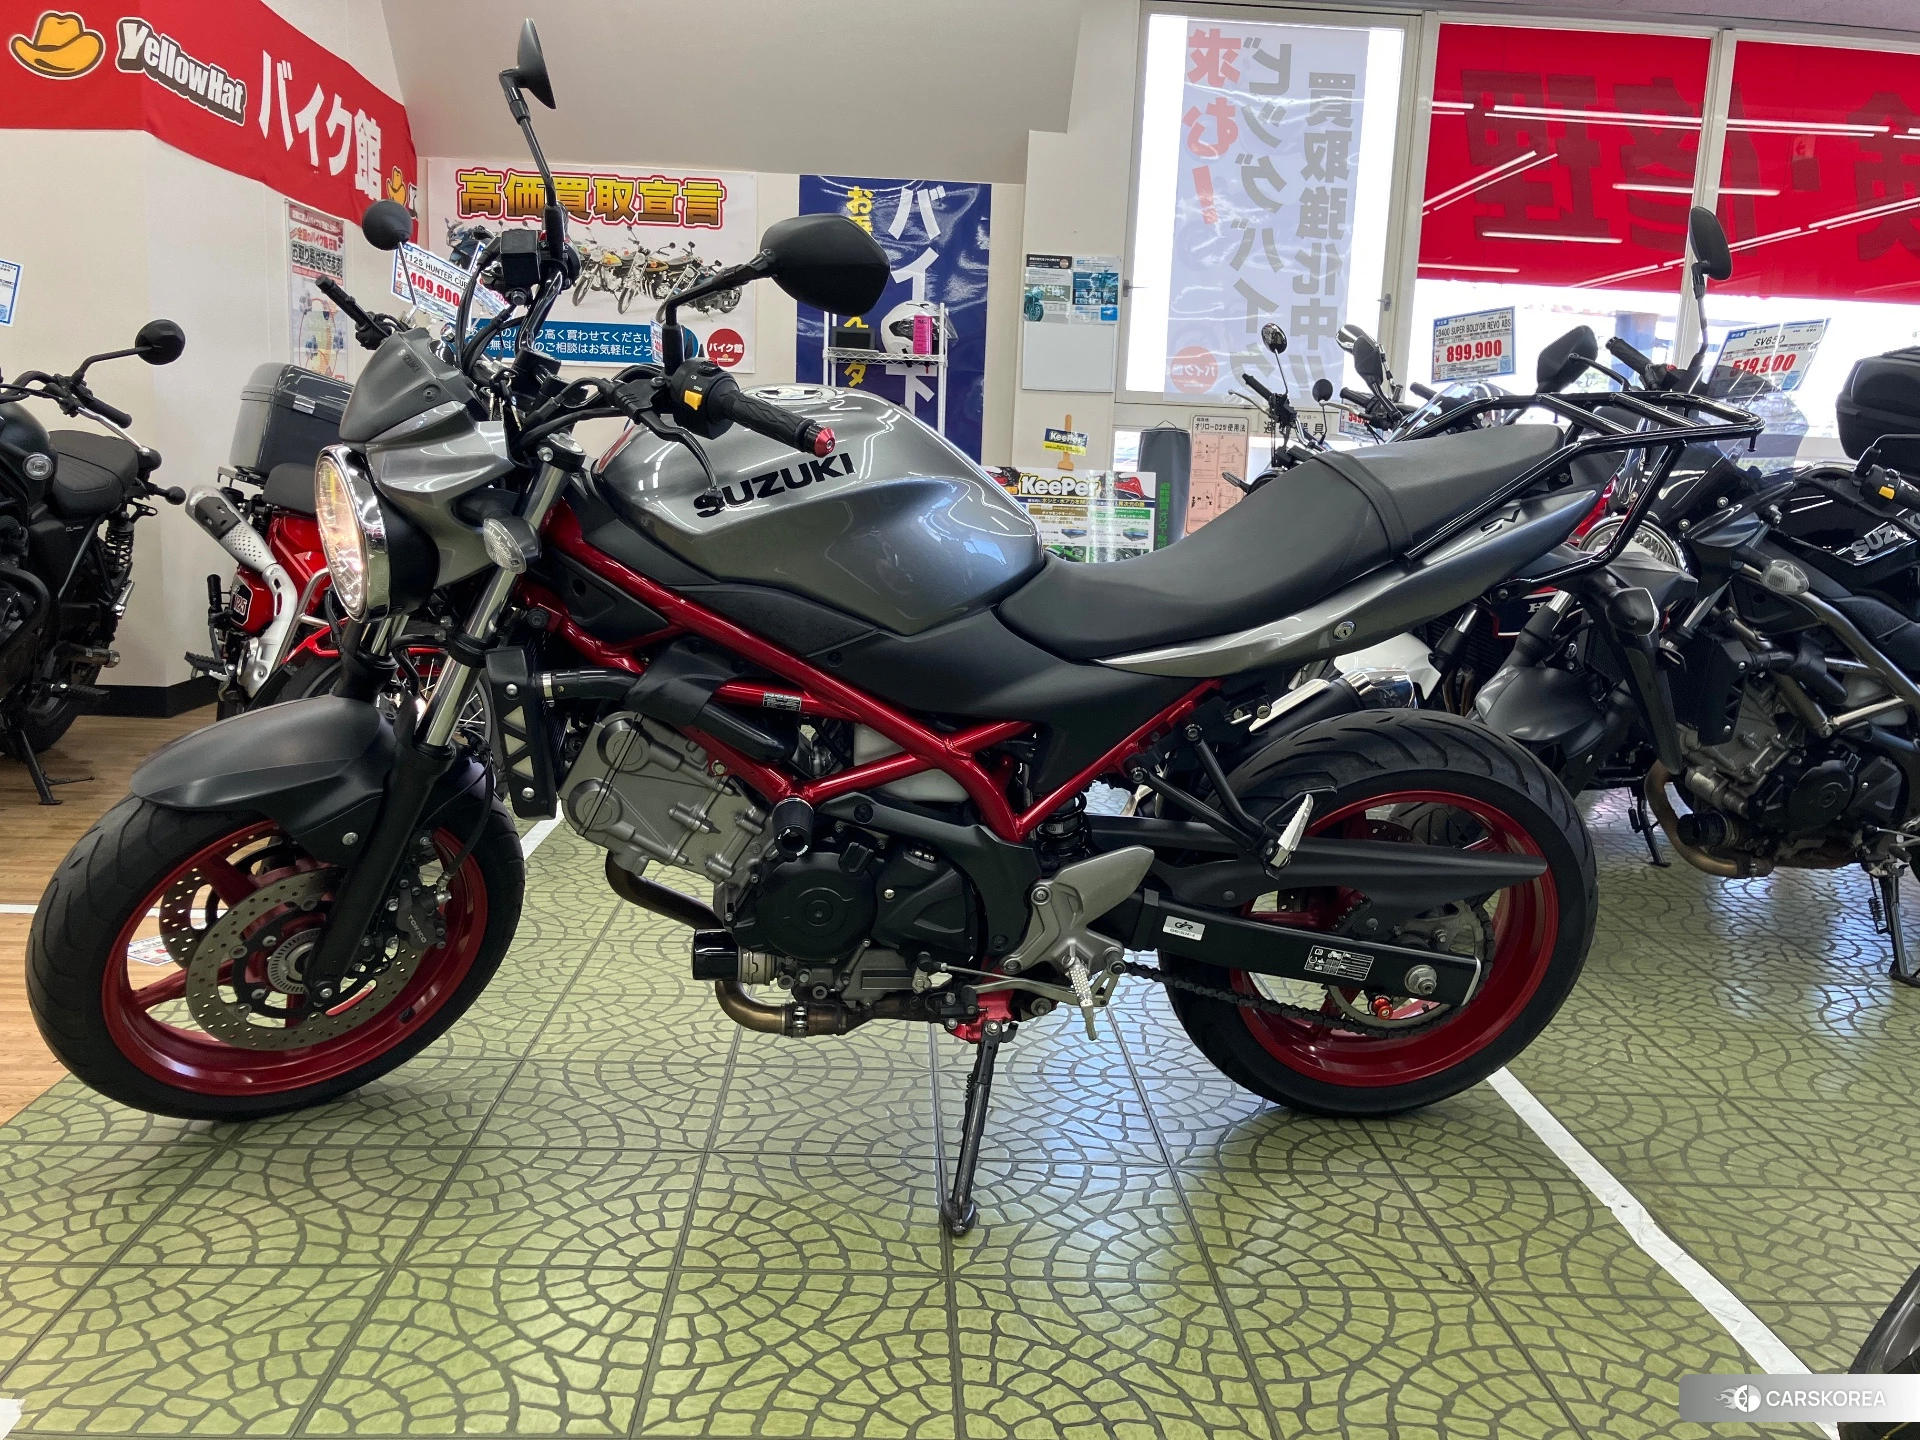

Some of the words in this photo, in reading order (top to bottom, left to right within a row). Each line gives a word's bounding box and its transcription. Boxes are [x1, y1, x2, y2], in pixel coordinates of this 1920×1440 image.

[118, 18, 246, 124] YellowHat
[258, 50, 382, 201] バイク館
[458, 168, 725, 228] 高価買取宣言
[425, 262, 453, 280] HUNTER
[1451, 325, 1465, 336] SUPER
[1754, 335, 1786, 347] SV650
[708, 342, 744, 354] バイク館
[1446, 339, 1502, 363] 899,900
[1730, 353, 1797, 377] 519,900
[1049, 431, 1082, 444] KeePer
[693, 452, 855, 518] SUZUKI
[1021, 474, 1100, 497] KeePer
[407, 914, 428, 944] TOKICO
